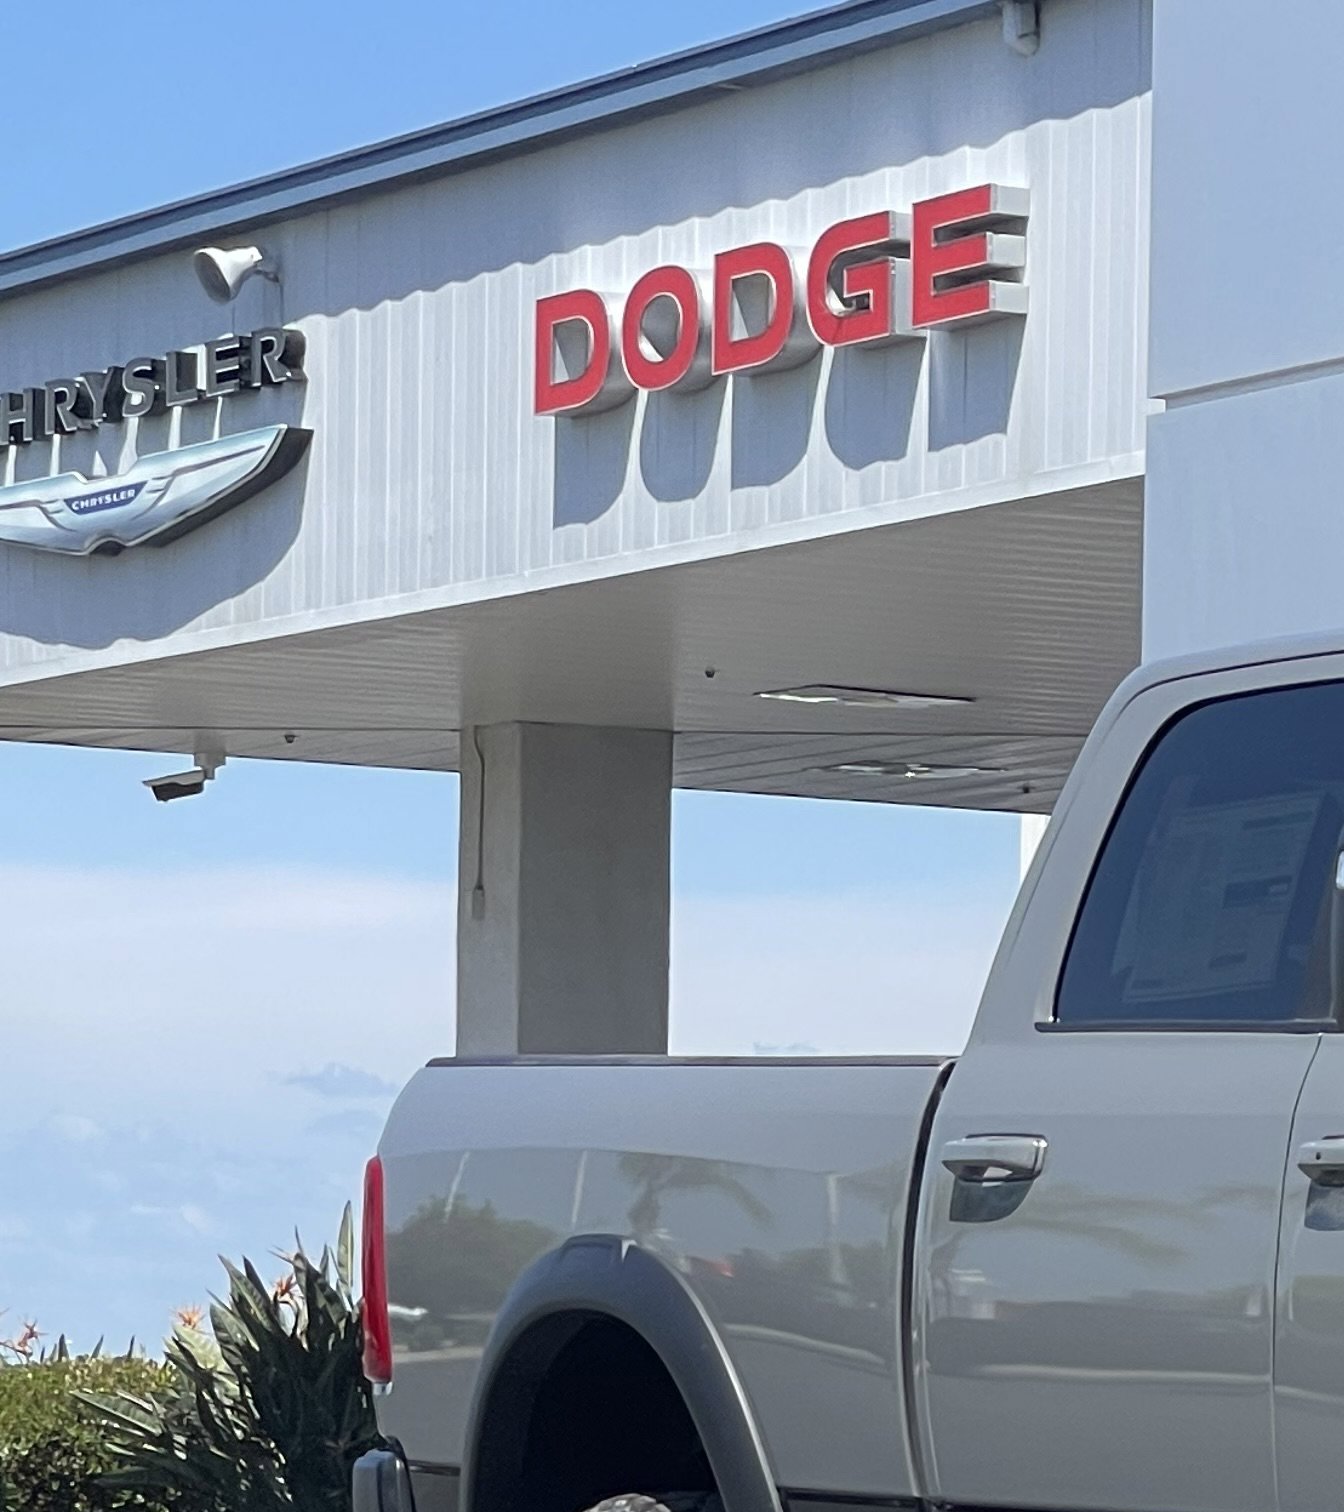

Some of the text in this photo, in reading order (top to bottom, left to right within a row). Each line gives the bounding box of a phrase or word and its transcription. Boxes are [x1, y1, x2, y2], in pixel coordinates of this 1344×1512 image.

[534, 183, 996, 417] DODGE
[0, 327, 289, 446] HRYSLER
[71, 489, 136, 511] CHRYSLER
